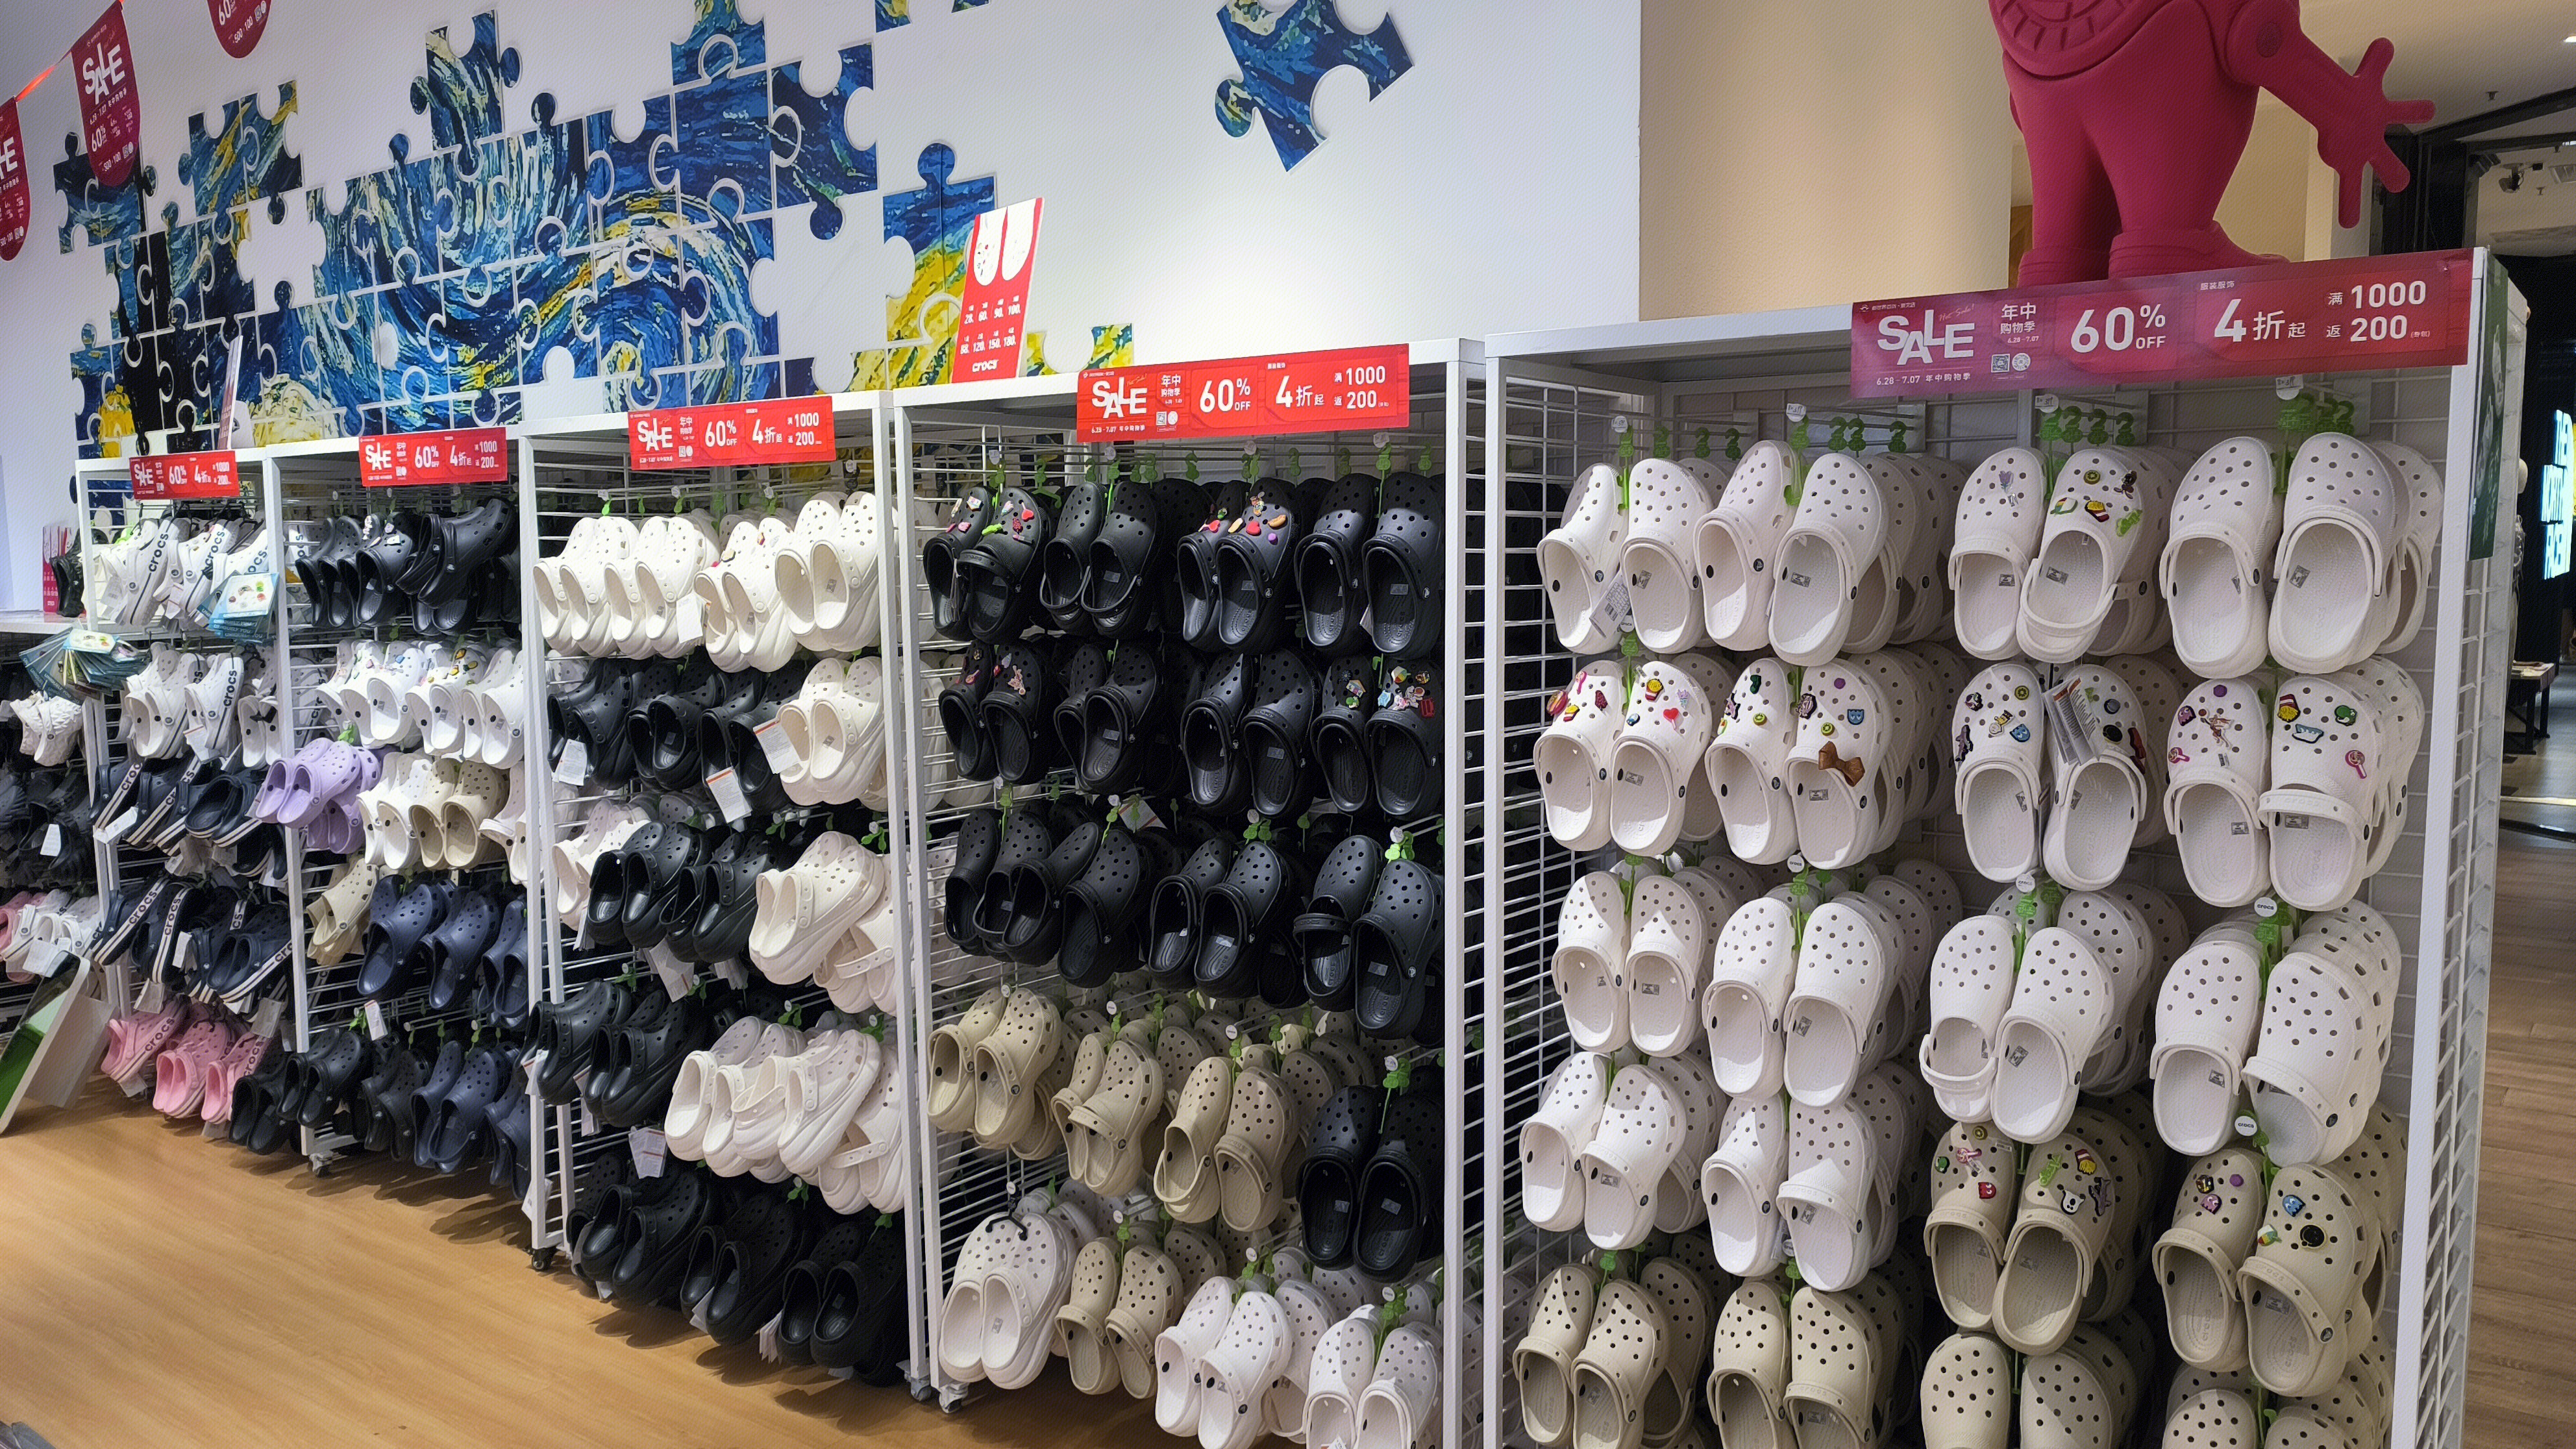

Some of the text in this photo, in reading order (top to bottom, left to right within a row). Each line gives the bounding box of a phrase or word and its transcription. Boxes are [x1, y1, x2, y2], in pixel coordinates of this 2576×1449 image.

[82, 42, 125, 105] SALE
[2200, 280, 2235, 291] 服装服饰
[2001, 302, 2037, 321] 年中
[1877, 309, 1975, 365] SALE
[2000, 321, 2035, 334] 购物季
[2136, 335, 2166, 349] OFF
[972, 359, 999, 372] crocs
[1161, 374, 1181, 386] 年中
[1926, 373, 1971, 382] 年中购物季
[1092, 377, 1147, 419] SALE
[1234, 401, 1251, 411] OFF
[637, 417, 673, 451] SALE
[726, 438, 737, 446] OFF
[365, 442, 392, 471] SALE
[134, 462, 154, 487] SALE
[148, 533, 169, 573] crocs
[204, 531, 225, 567] crocs
[223, 670, 238, 707] crocs
[121, 762, 142, 791] croc
[129, 891, 157, 925] crocs
[164, 897, 181, 935] crocs
[145, 1017, 175, 1052] crocs
